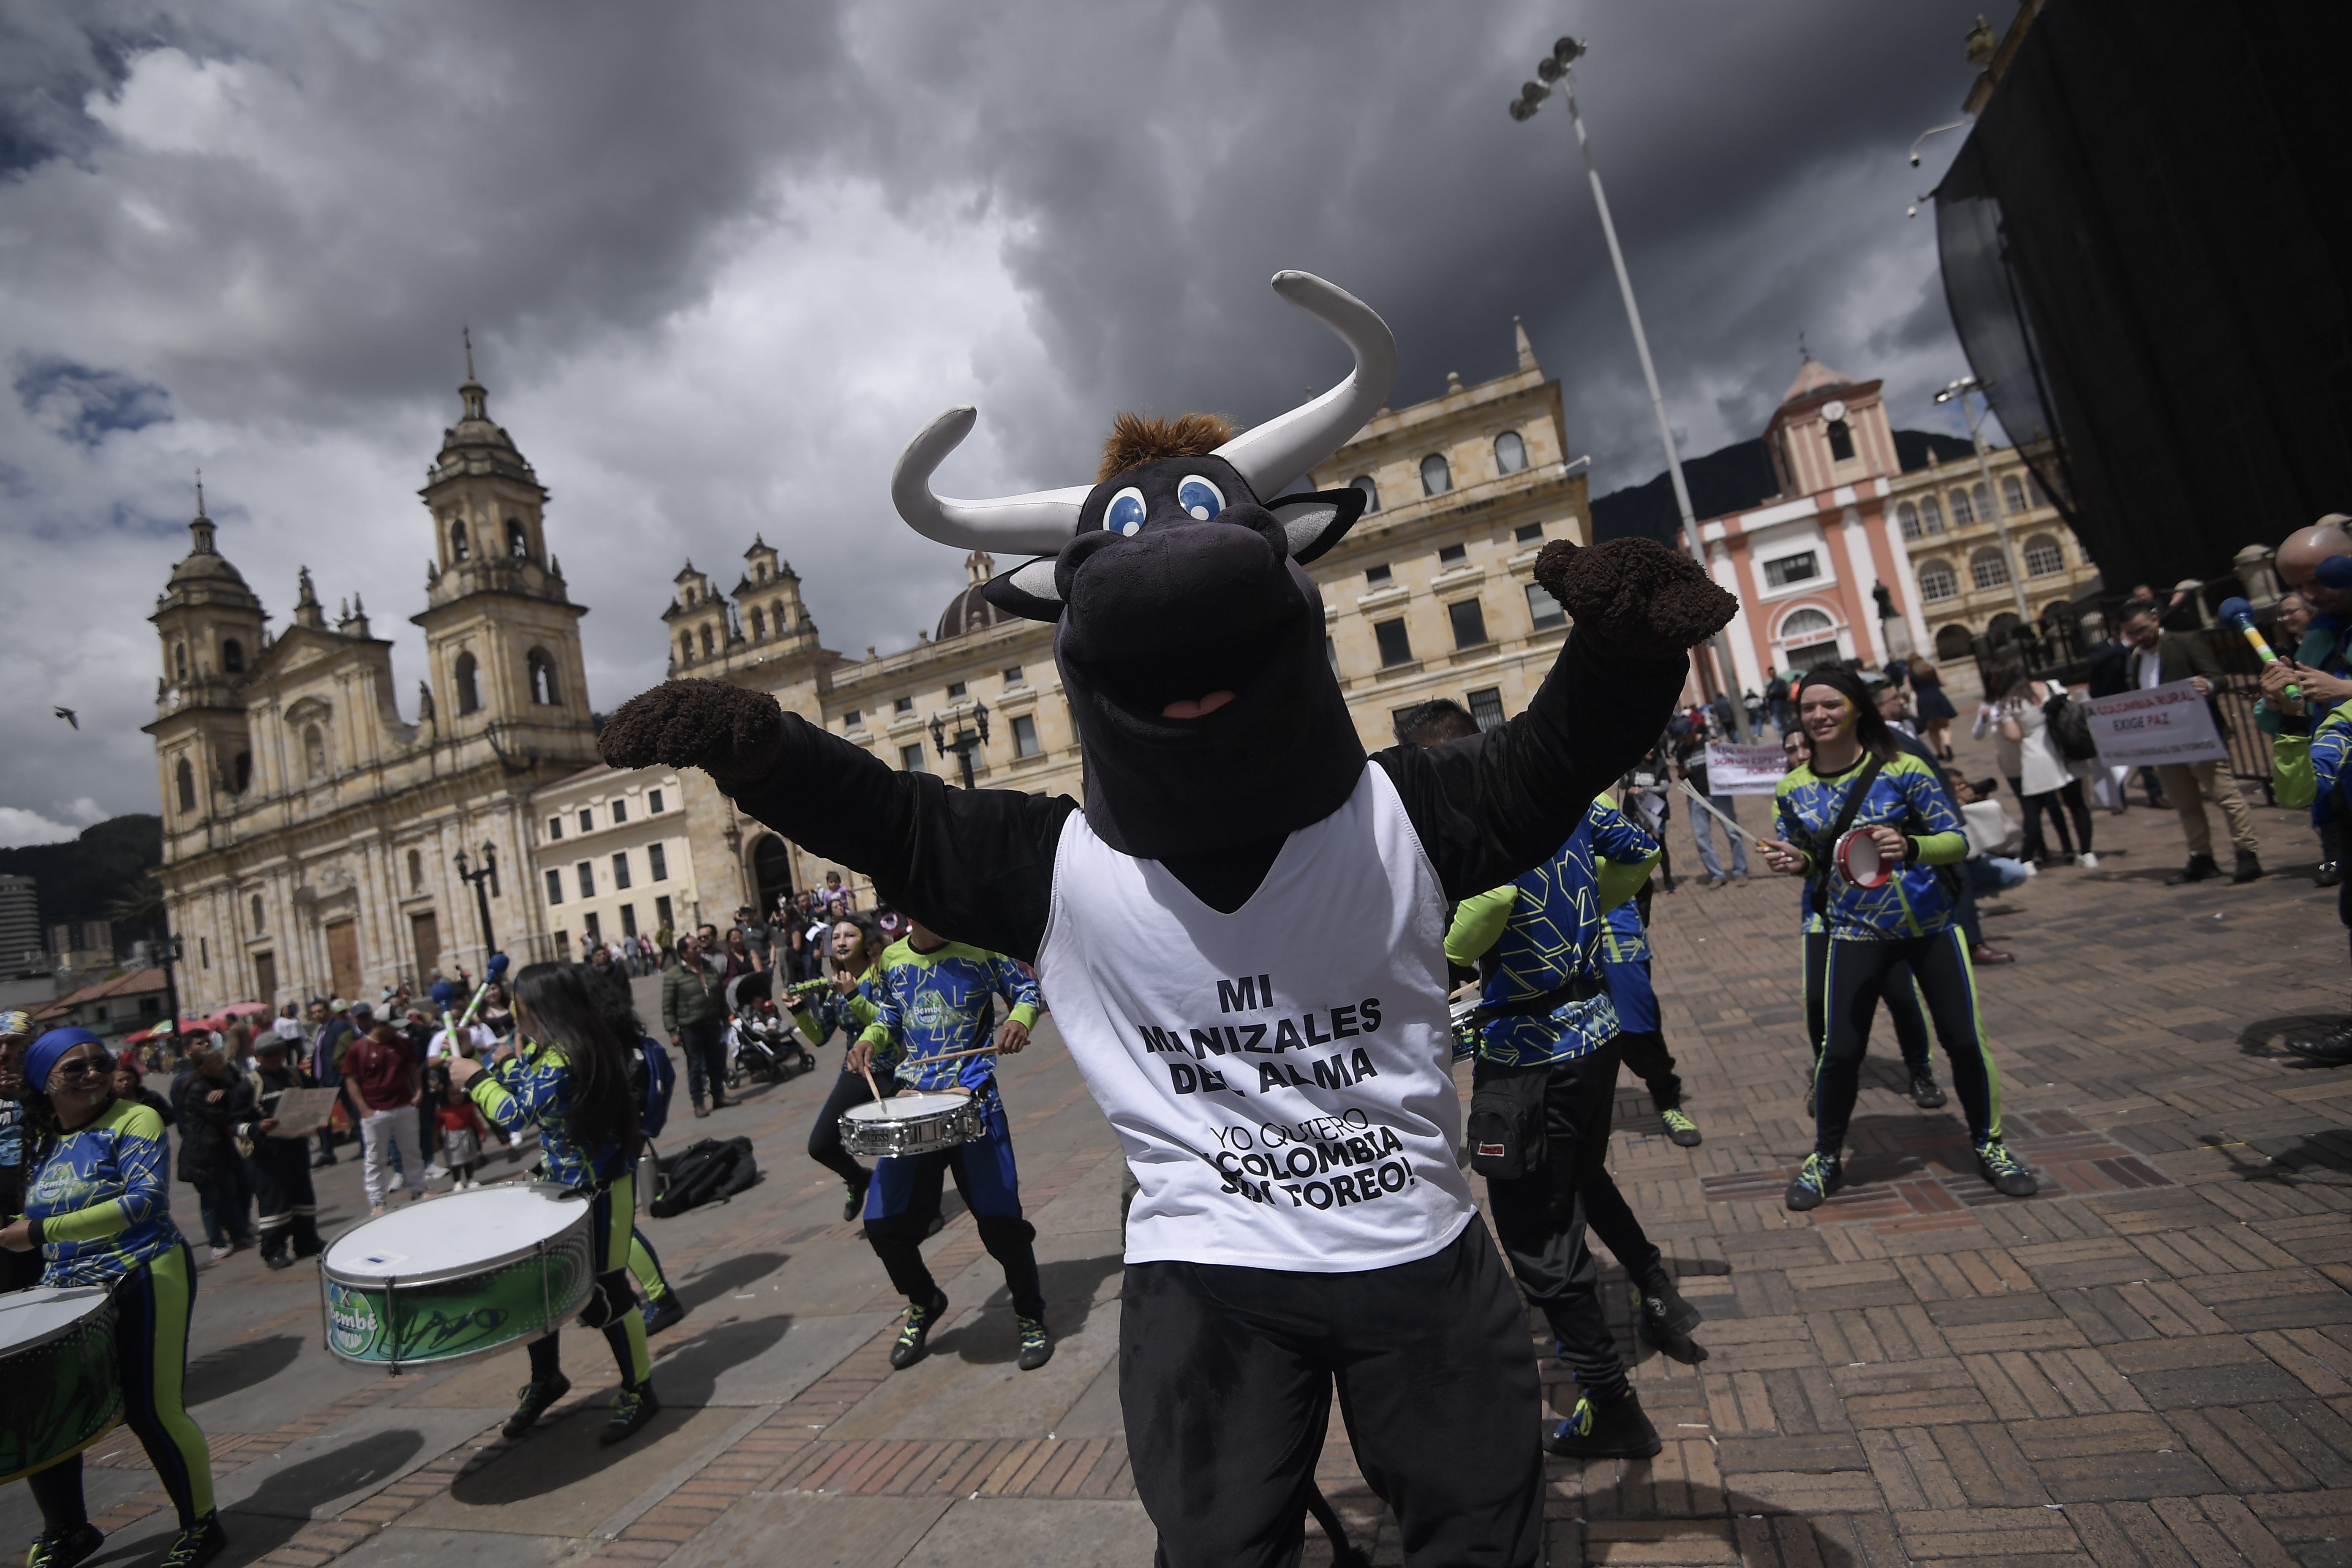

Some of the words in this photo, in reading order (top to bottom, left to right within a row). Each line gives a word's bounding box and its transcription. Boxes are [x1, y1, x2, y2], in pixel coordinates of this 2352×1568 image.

[2096, 698, 2156, 715] COLOMBIA
[2154, 690, 2195, 705] RURAL
[2113, 716, 2144, 731] EXIGE
[2146, 712, 2170, 726] PAZ
[1216, 974, 1274, 1014] MI
[1138, 997, 1382, 1060] MANIZALES
[1169, 1063, 1246, 1097] DEL
[1258, 1047, 1379, 1094] ALMA
[1209, 1126, 1254, 1151] YO
[1260, 1108, 1369, 1149] QUIERO
[1220, 1172, 1276, 1206] SIN
[1277, 1157, 1415, 1211] TOREO!
[329, 1301, 378, 1331] Bembé
